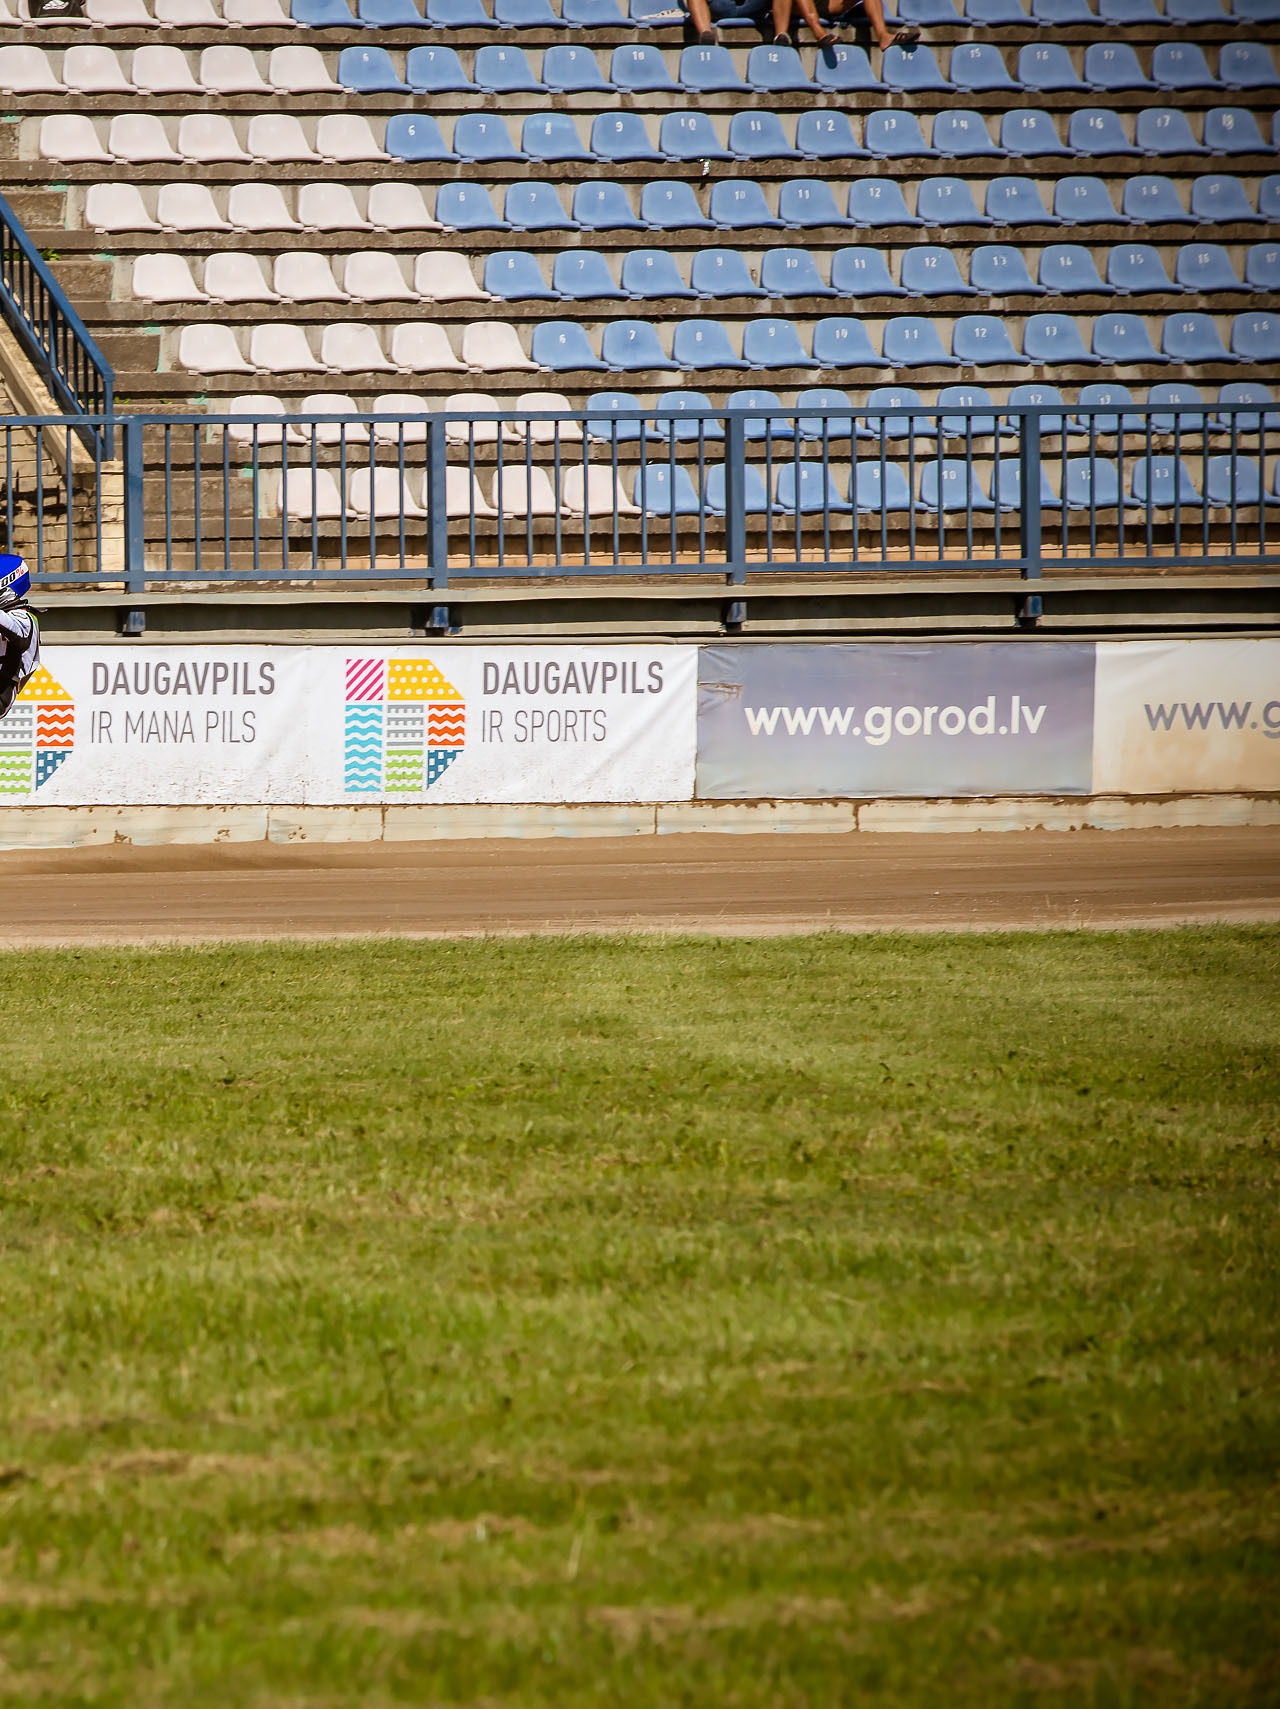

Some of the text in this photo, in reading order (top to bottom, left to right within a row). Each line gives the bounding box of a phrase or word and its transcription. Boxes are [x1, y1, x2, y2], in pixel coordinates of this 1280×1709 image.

[92, 661, 276, 696] DAUGAVPILS
[483, 661, 664, 695] DAUGAVPILS
[91, 709, 256, 744] IR MANA PILS
[482, 709, 607, 743] IR SPORTS
[744, 695, 1047, 746] www.gorod.lv
